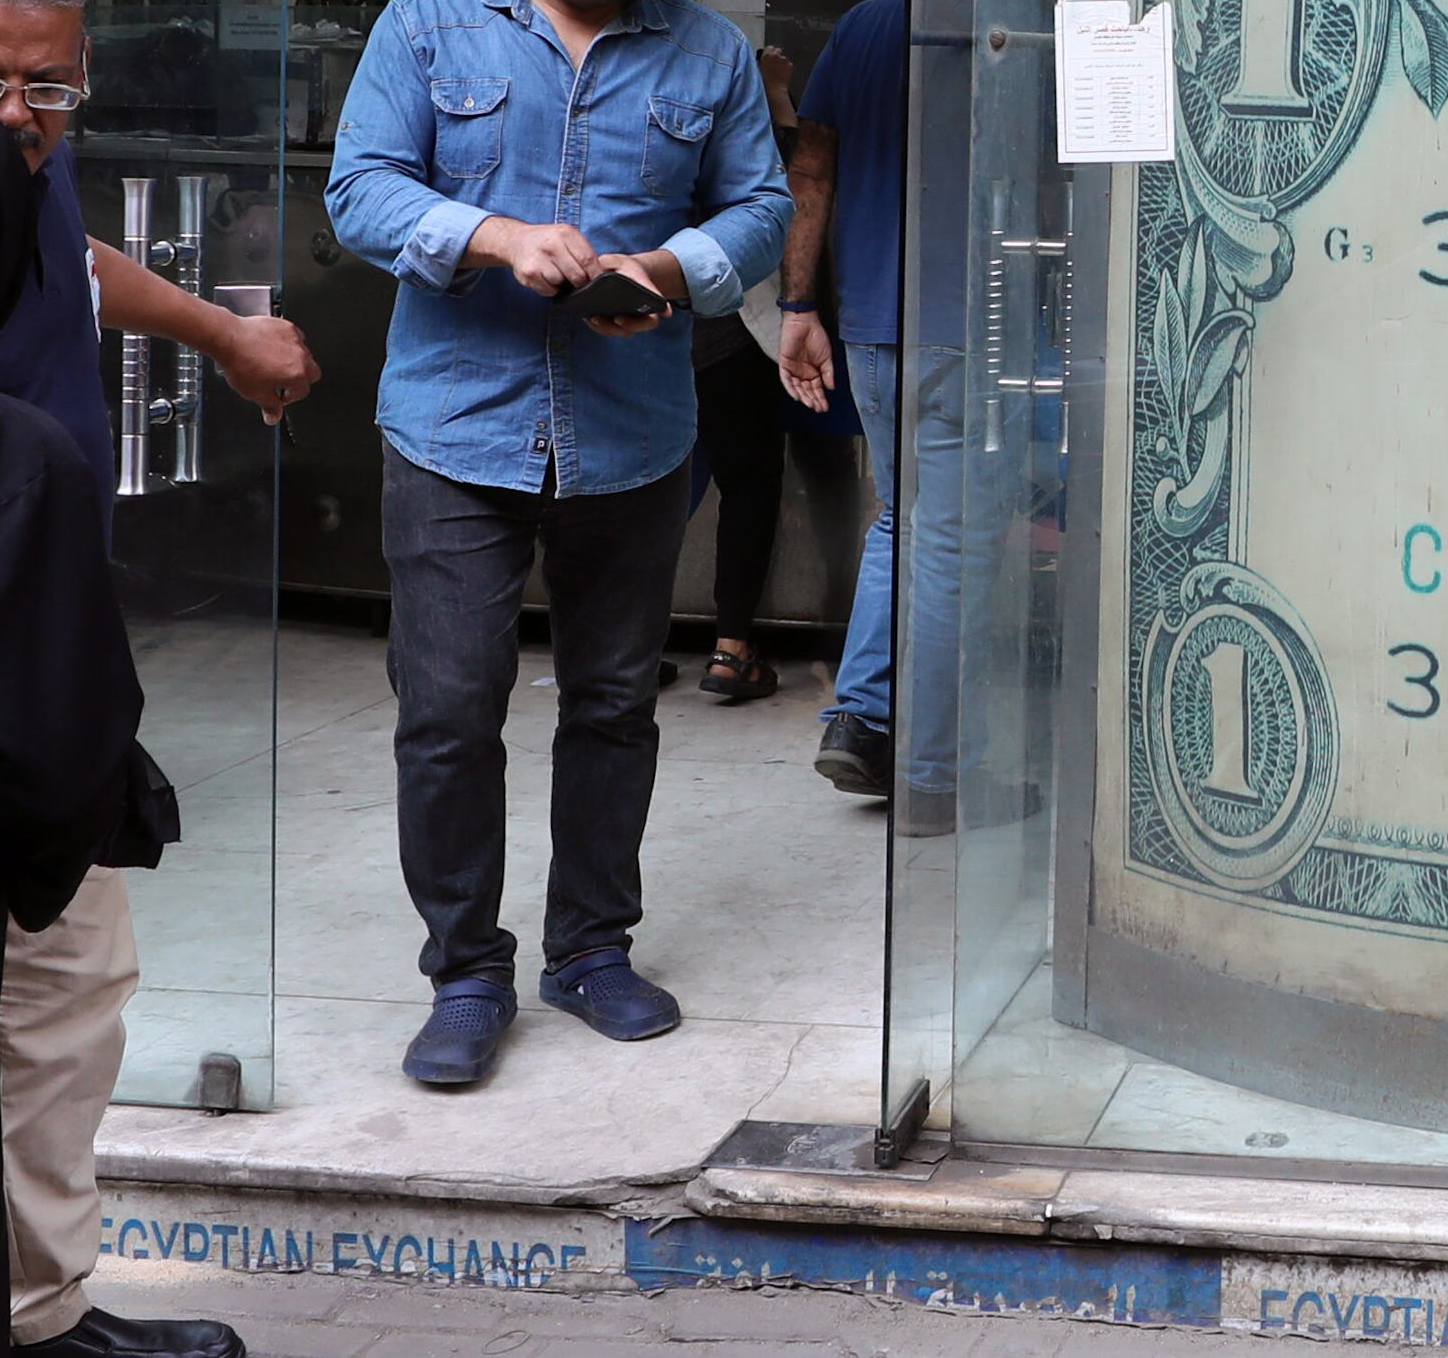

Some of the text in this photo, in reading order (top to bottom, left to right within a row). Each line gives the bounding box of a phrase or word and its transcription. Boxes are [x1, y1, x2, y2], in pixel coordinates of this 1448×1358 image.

[1401, 523, 1442, 594] C
[1386, 643, 1441, 719] 3
[1200, 640, 1264, 808] 1
